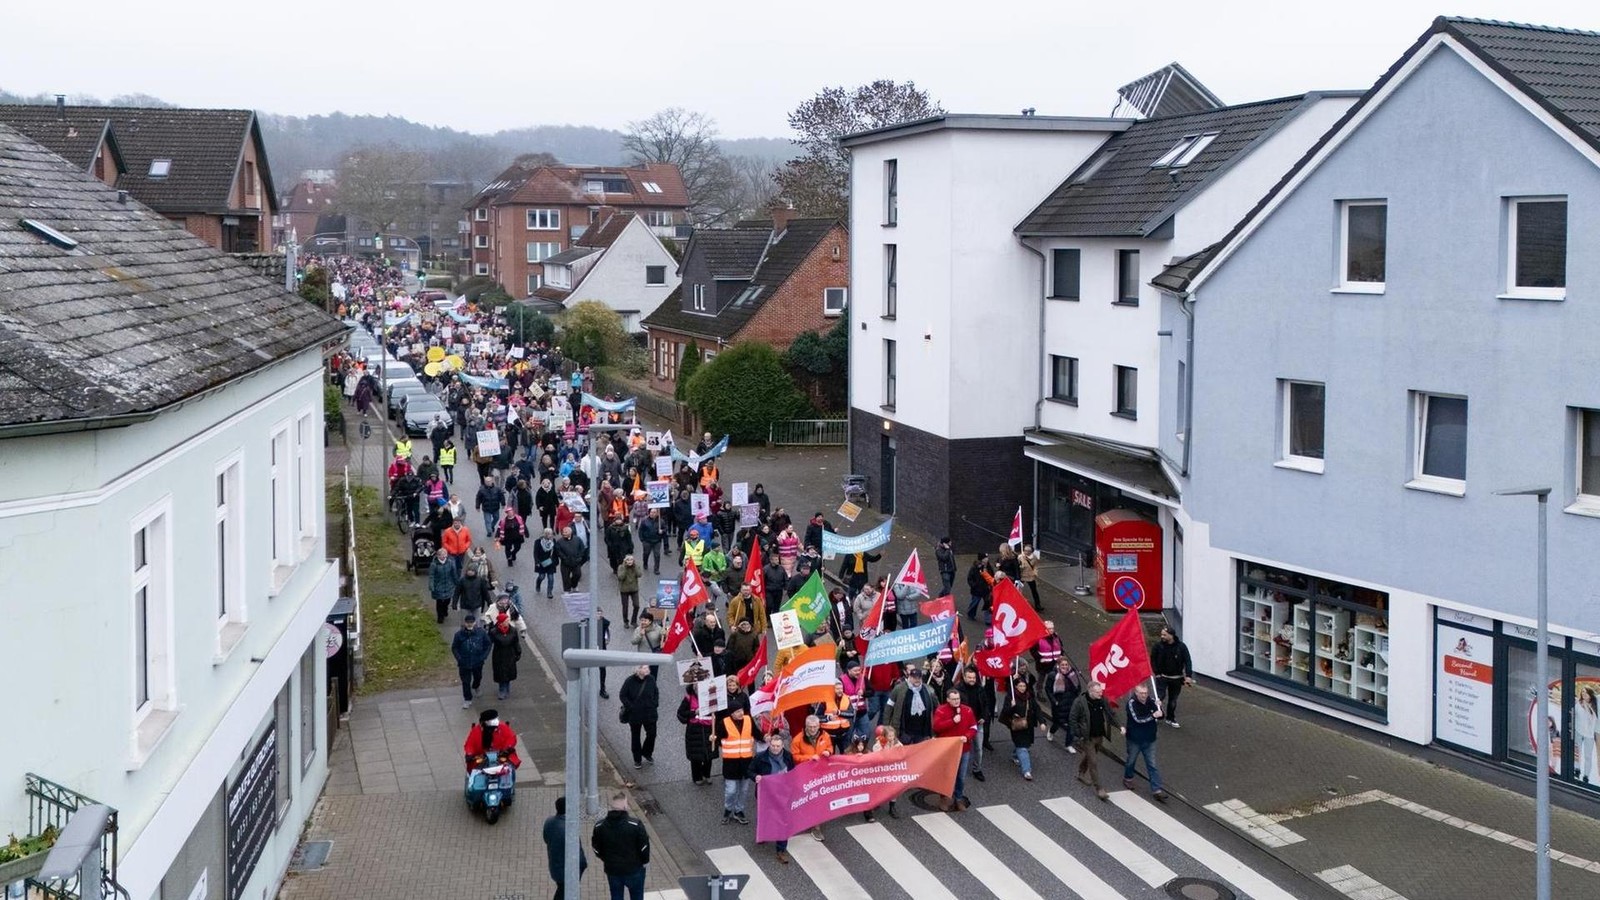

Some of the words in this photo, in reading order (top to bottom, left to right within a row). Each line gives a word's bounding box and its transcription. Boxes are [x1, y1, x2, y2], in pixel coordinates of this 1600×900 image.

[1074, 490, 1091, 510] SALE
[919, 623, 948, 638] STATT
[790, 796, 809, 811] Rettet
[819, 772, 922, 796] Gesundheitsversorgun
[802, 772, 836, 793] Solidarität
[837, 769, 851, 780] für
